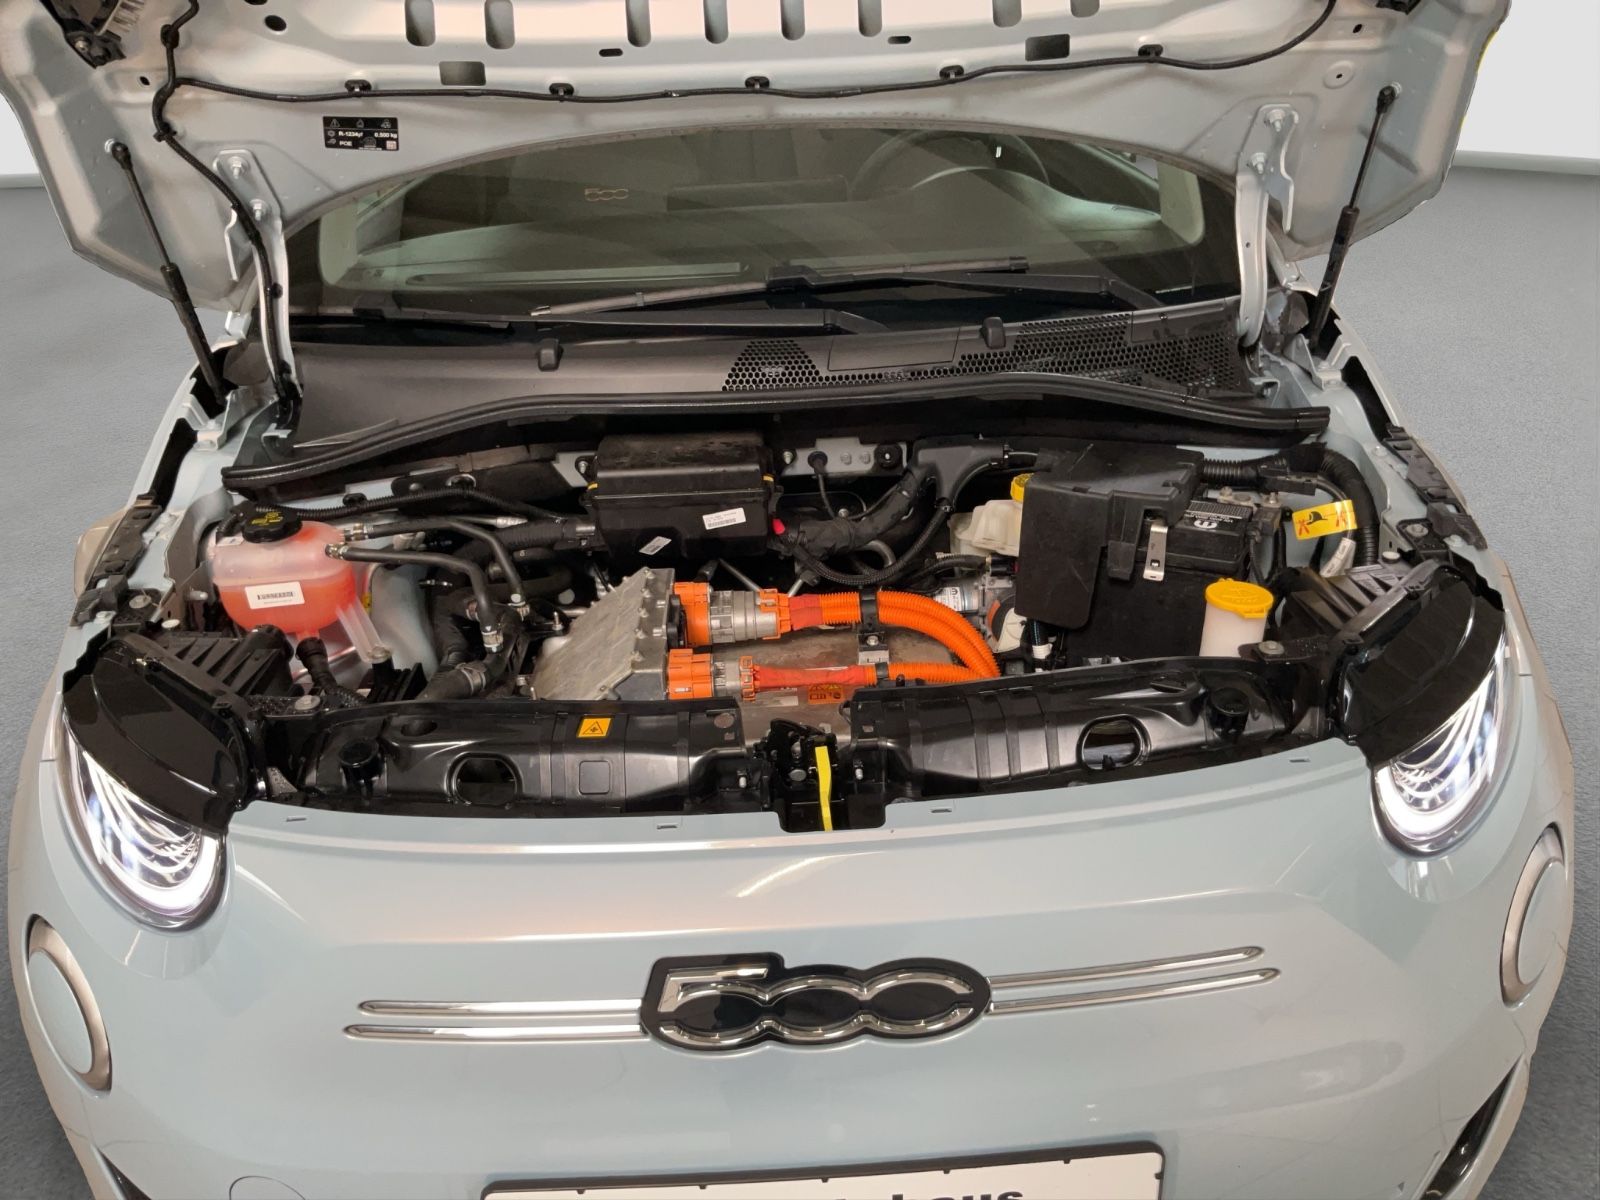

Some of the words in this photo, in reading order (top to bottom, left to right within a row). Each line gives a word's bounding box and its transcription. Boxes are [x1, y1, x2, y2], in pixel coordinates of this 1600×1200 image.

[338, 130, 364, 138] R-1234yf
[584, 188, 629, 202] 500
[656, 963, 975, 1047] 500
